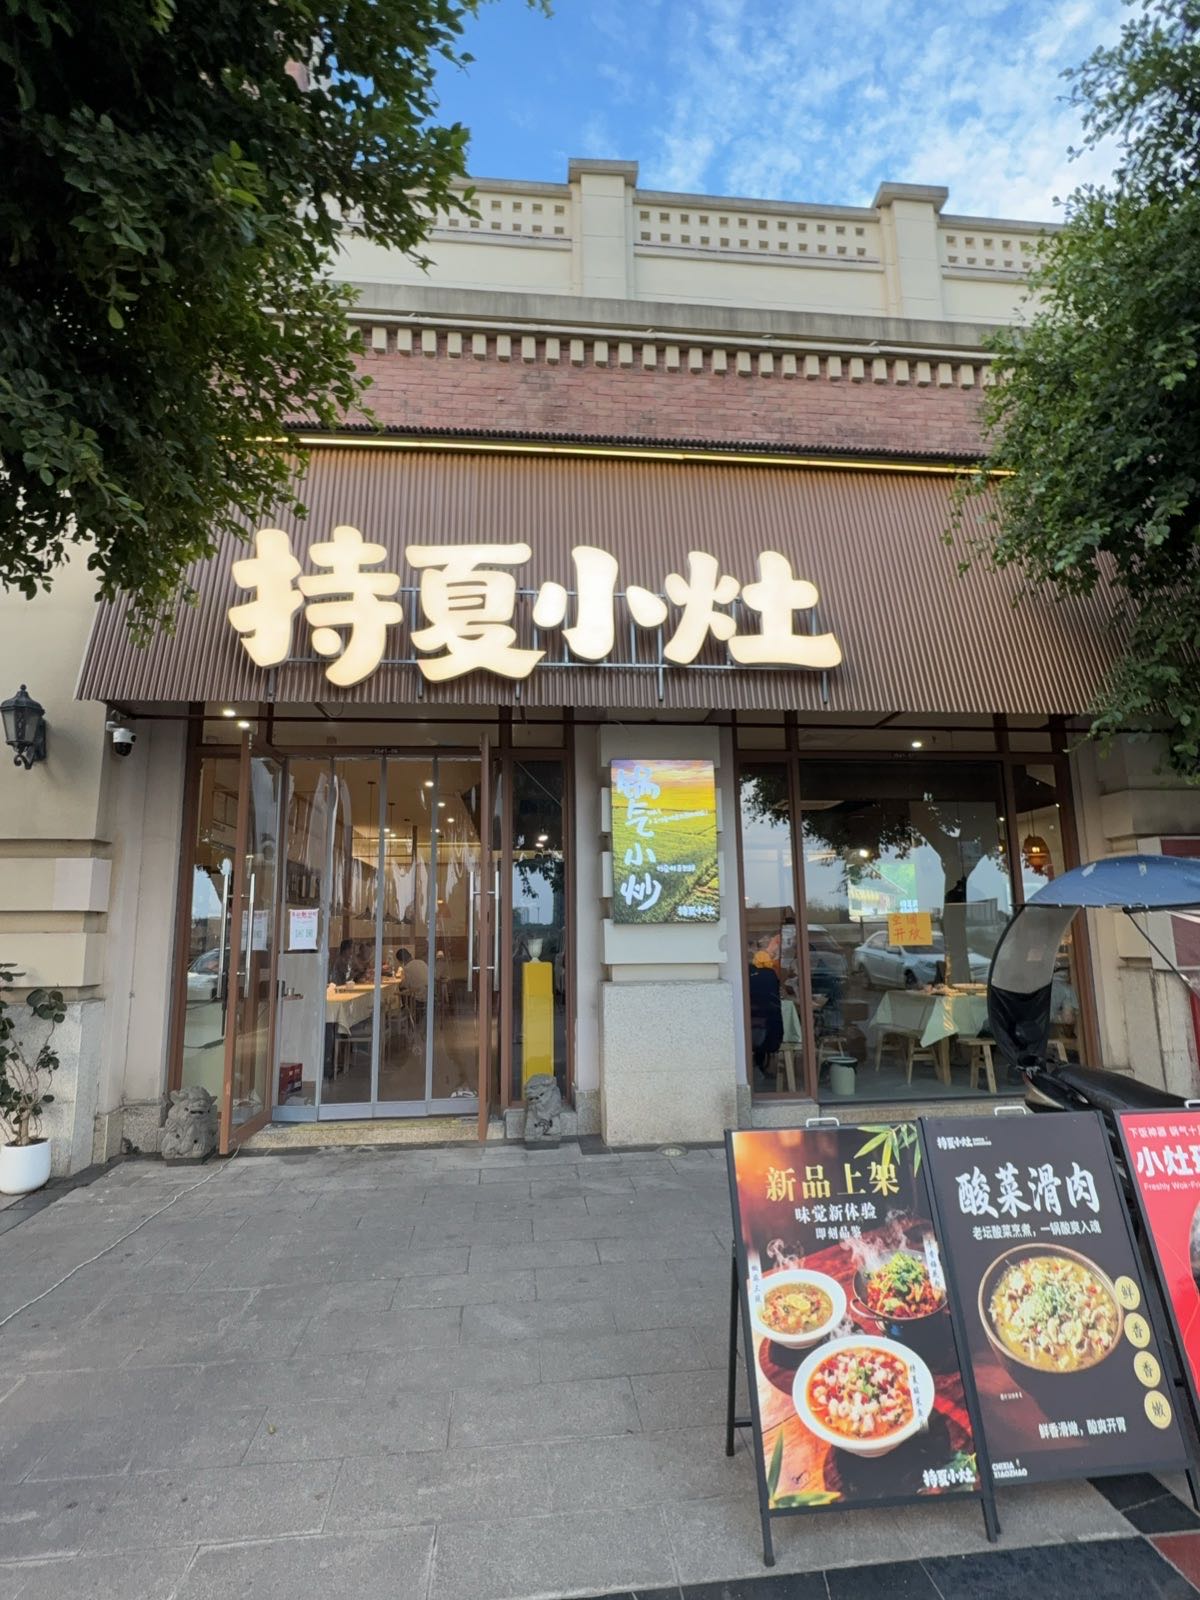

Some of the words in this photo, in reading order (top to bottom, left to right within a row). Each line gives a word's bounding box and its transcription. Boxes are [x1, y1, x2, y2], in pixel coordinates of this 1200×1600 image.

[228, 525, 842, 688] 持夏小灶
[1168, 1124, 1200, 1136] 锅气十
[766, 1161, 900, 1202] 新品上架
[955, 1162, 1100, 1218] 酸菜滑肉
[794, 1201, 877, 1224] 味觉新体验
[922, 1467, 975, 1489] 持夏小灶
